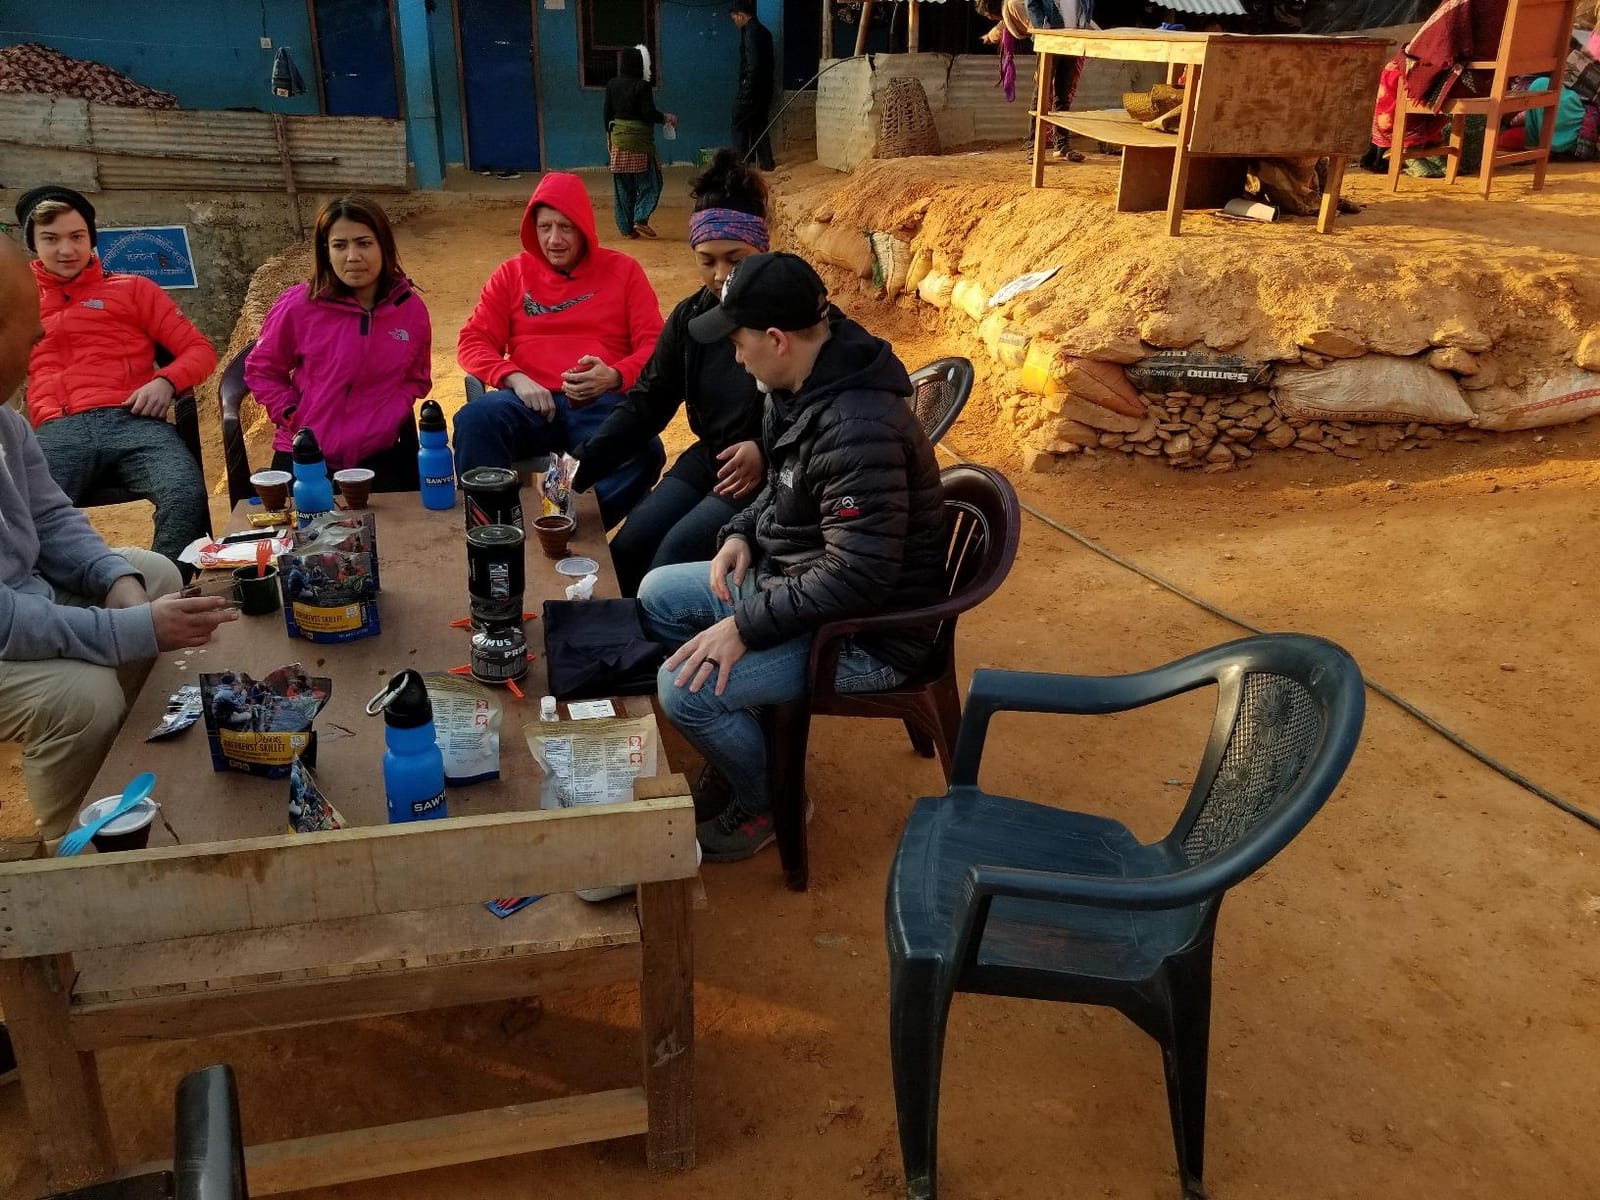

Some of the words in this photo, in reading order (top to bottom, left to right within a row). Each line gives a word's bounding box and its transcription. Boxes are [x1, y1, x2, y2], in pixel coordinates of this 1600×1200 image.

[1187, 369, 1249, 383] Sammo
[472, 633, 512, 647] IMUS
[413, 789, 446, 812] SAWY
